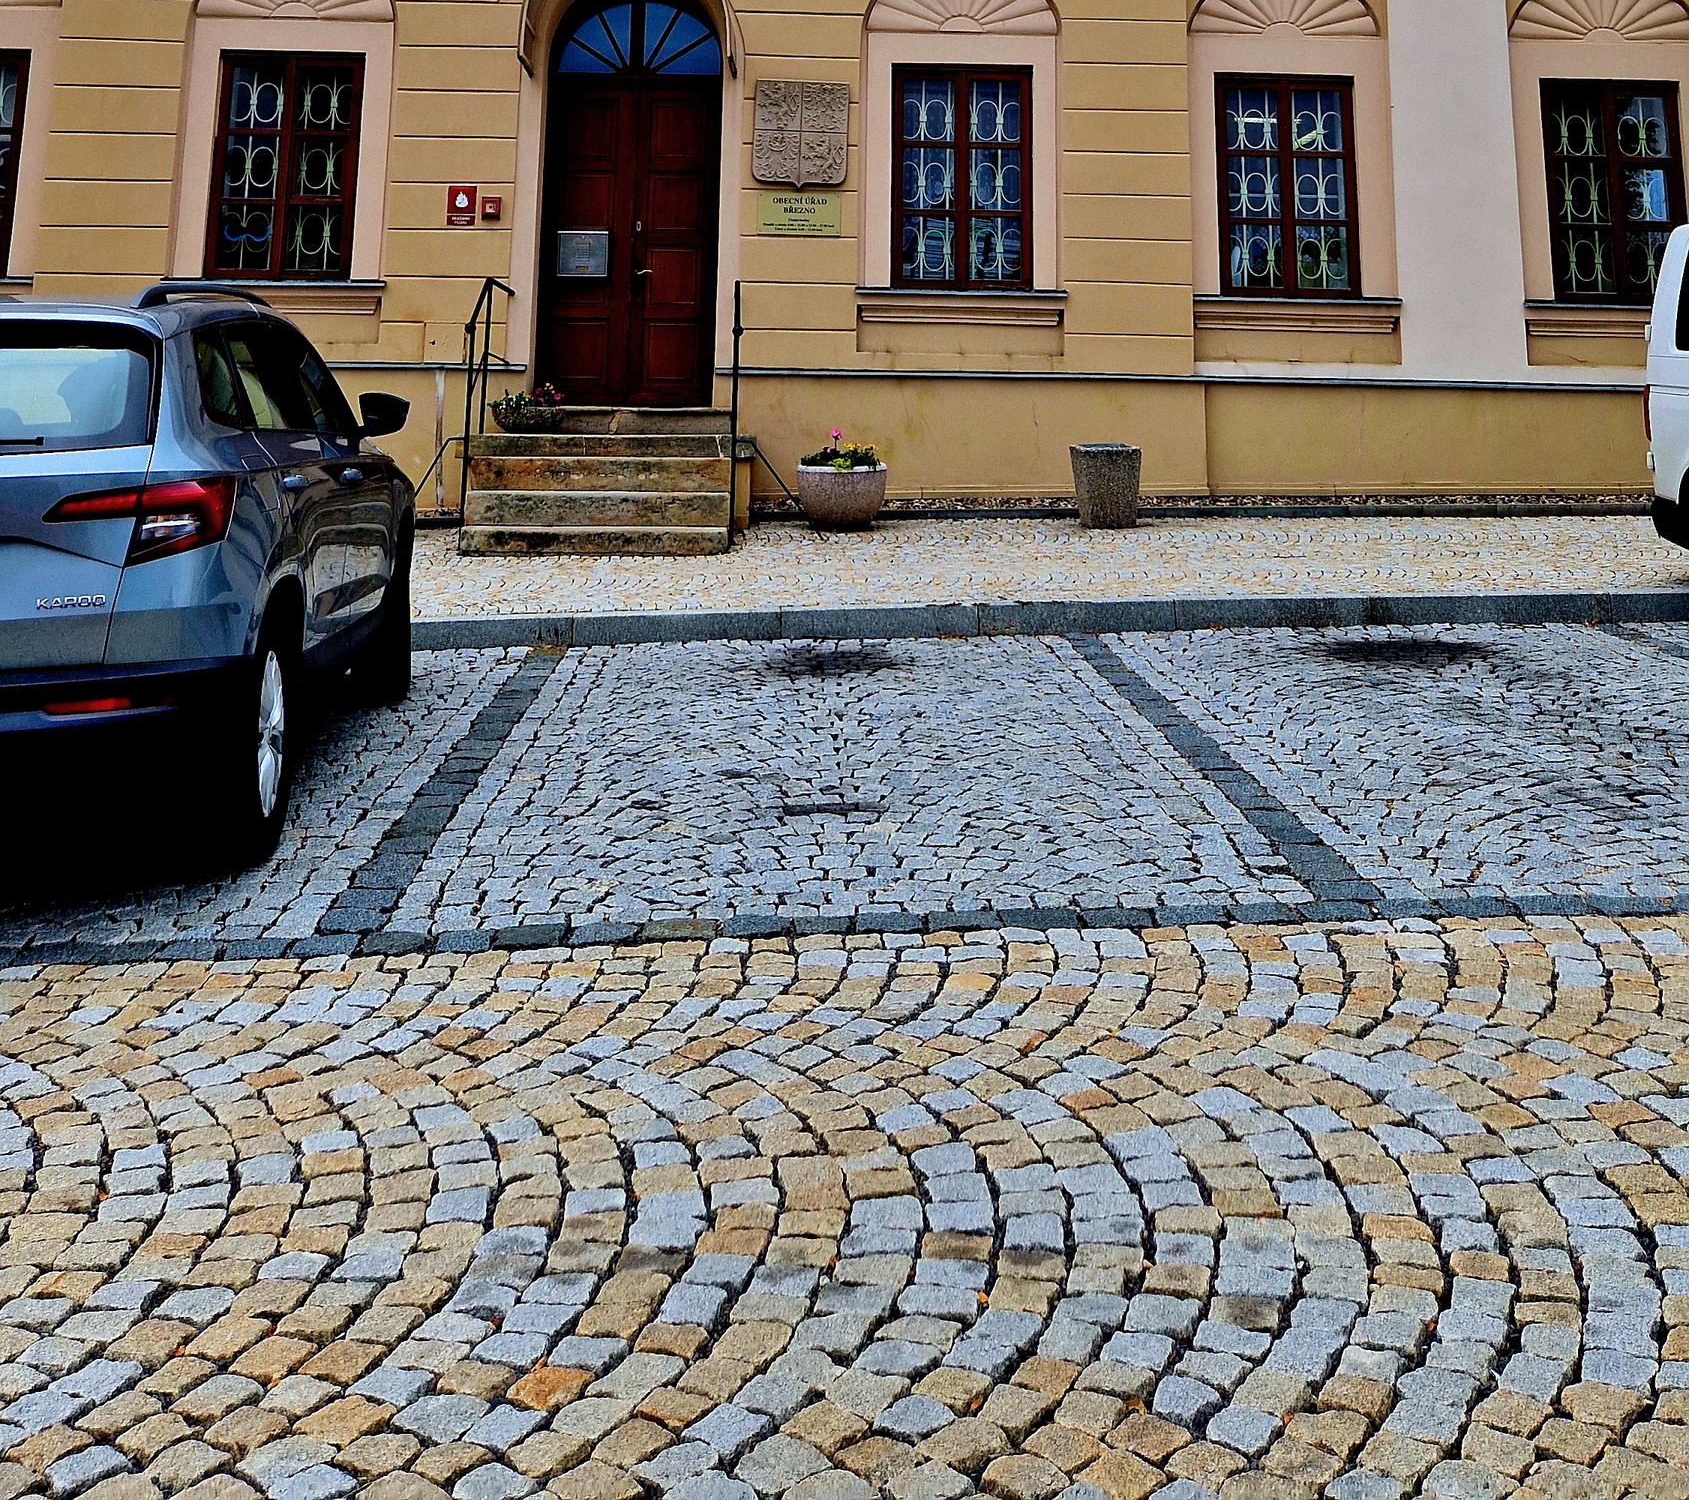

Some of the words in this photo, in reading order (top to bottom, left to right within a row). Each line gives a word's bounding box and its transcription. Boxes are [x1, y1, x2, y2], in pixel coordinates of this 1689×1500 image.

[772, 196, 803, 205] OBECNÍ
[805, 196, 828, 205] ÚŘAD
[783, 206, 816, 214] BŘEZNO
[36, 594, 106, 610] KAROQ
